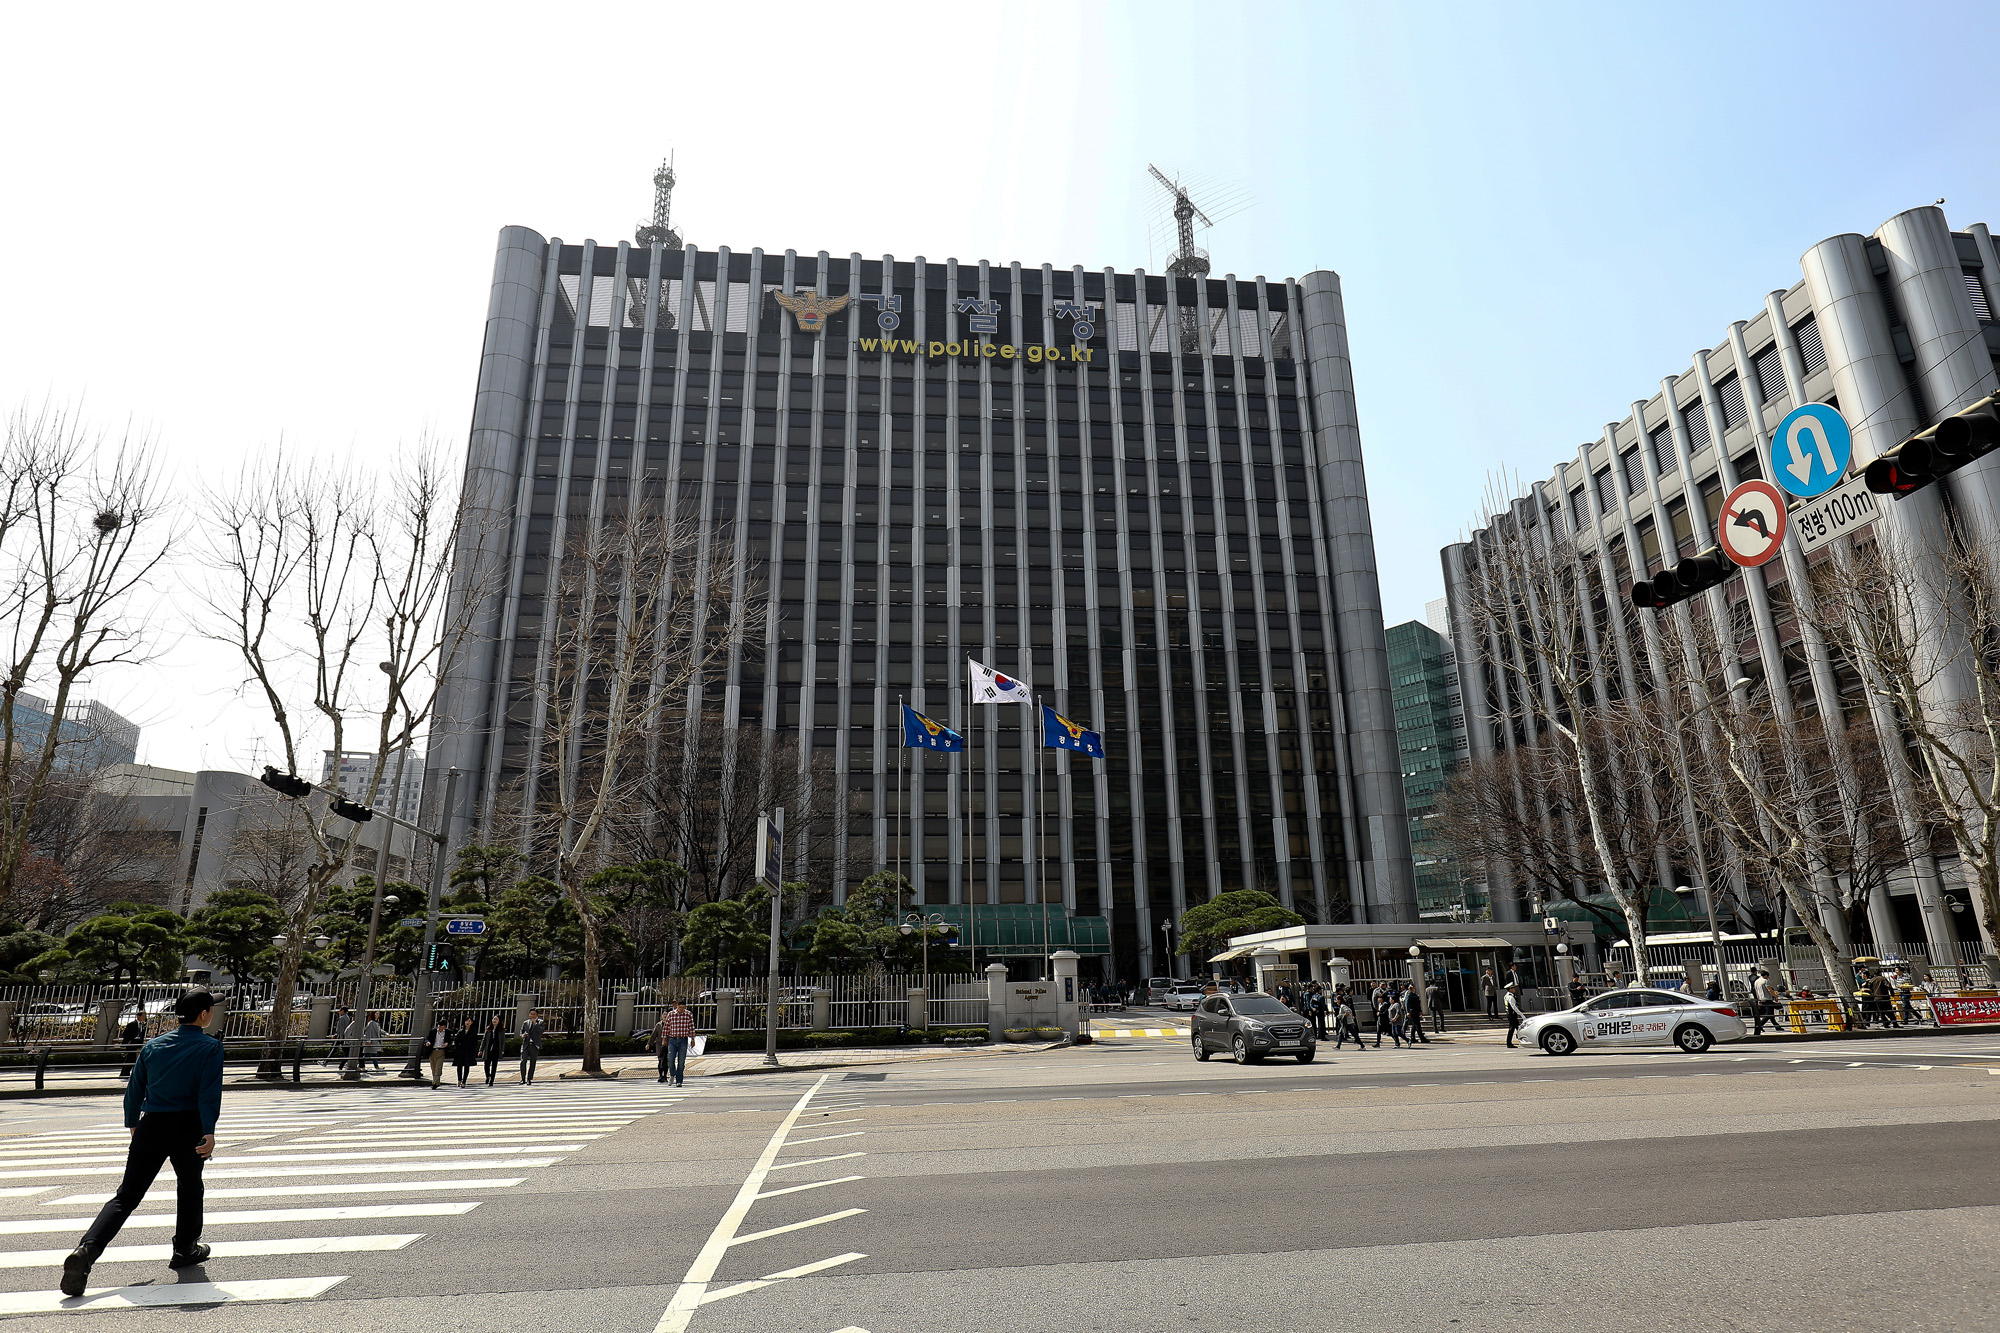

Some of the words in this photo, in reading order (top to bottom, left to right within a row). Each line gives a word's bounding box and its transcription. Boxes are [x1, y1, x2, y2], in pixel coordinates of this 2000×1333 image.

[859, 337, 1094, 363] www.police.go.kr
[1935, 1001, 1956, 1017] 경찰은
[1956, 1001, 1977, 1017] 국민과
[1646, 1022, 1667, 1032] 구하라
